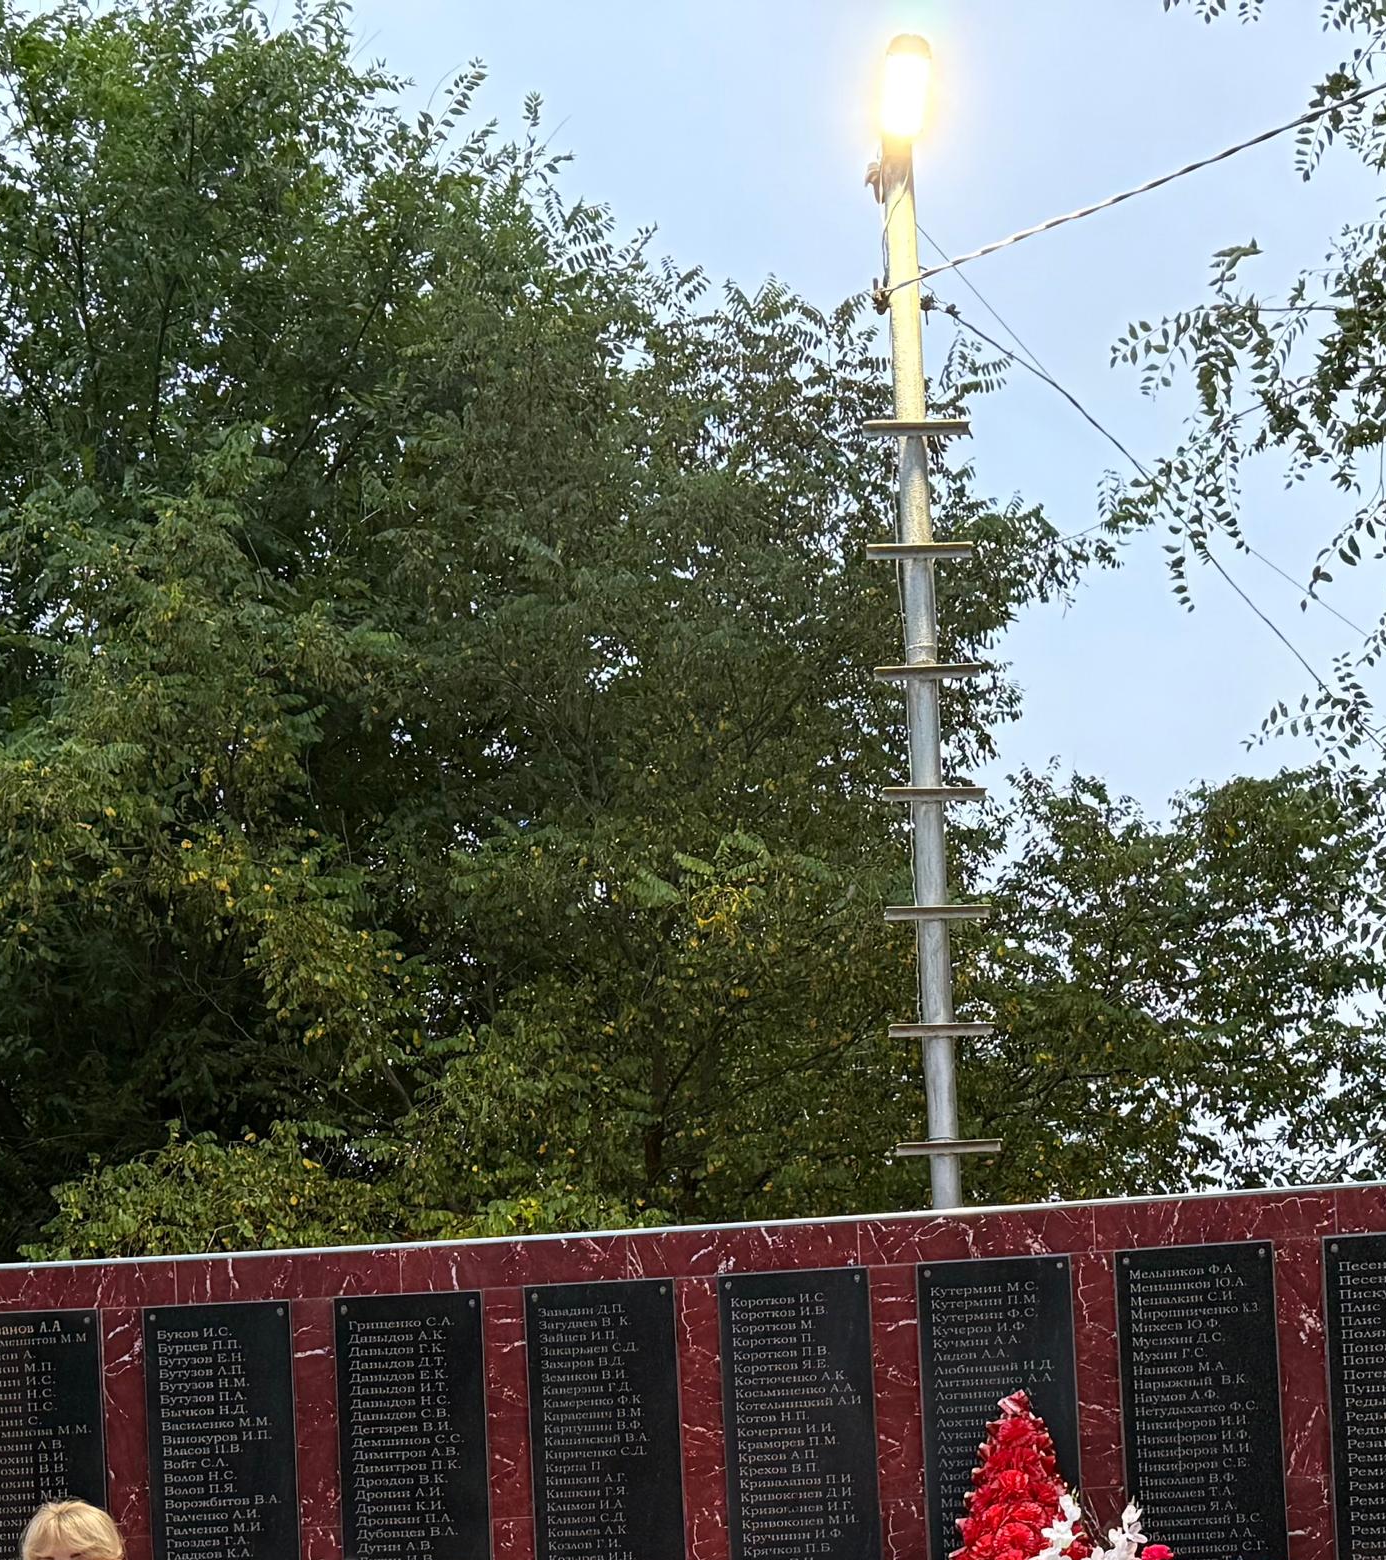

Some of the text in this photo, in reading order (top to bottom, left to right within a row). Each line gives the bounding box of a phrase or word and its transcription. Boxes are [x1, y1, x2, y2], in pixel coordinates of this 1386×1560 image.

[1129, 1268, 1204, 1280] Мельников
[930, 1281, 1038, 1298] Кутермин М.С.
[1130, 1281, 1210, 1293] Меньшиков
[1340, 1303, 1381, 1313] Плис
[731, 1309, 795, 1321] Коротков
[932, 1312, 1002, 1324] Кутермин
[349, 1320, 421, 1332] Грищенко
[933, 1325, 992, 1337] Кучеров
[1131, 1322, 1182, 1333] Михеев
[157, 1327, 232, 1342] Буков И.С.
[348, 1330, 447, 1344] Давыдов А.К.
[540, 1333, 586, 1343] Зайцев
[158, 1340, 242, 1355] Бурцев П.П.
[1133, 1351, 1177, 1363] Мухин
[349, 1360, 414, 1371] Давыдов
[541, 1360, 594, 1370] Захаров
[735, 1374, 817, 1386] Костюченко
[934, 1377, 1022, 1388] Литвиненко
[1135, 1393, 1186, 1404] Наумов
[161, 1404, 248, 1418] Бычков Н.Д.
[162, 1417, 272, 1431] Василенко М.М.
[736, 1414, 776, 1424] Котов
[352, 1421, 453, 1436] Дегтярев В.И.
[737, 1426, 801, 1438] Кочергин
[163, 1430, 272, 1445] Винокуров И.П.
[435, 1434, 464, 1443] С.С.
[164, 1460, 196, 1470] Войт
[739, 1466, 787, 1477] Крехов
[1139, 1475, 1204, 1487] Николаев
[165, 1498, 250, 1510] Ворожбитов
[356, 1530, 425, 1541] Дубовцев
[167, 1552, 222, 1560] Гладков
